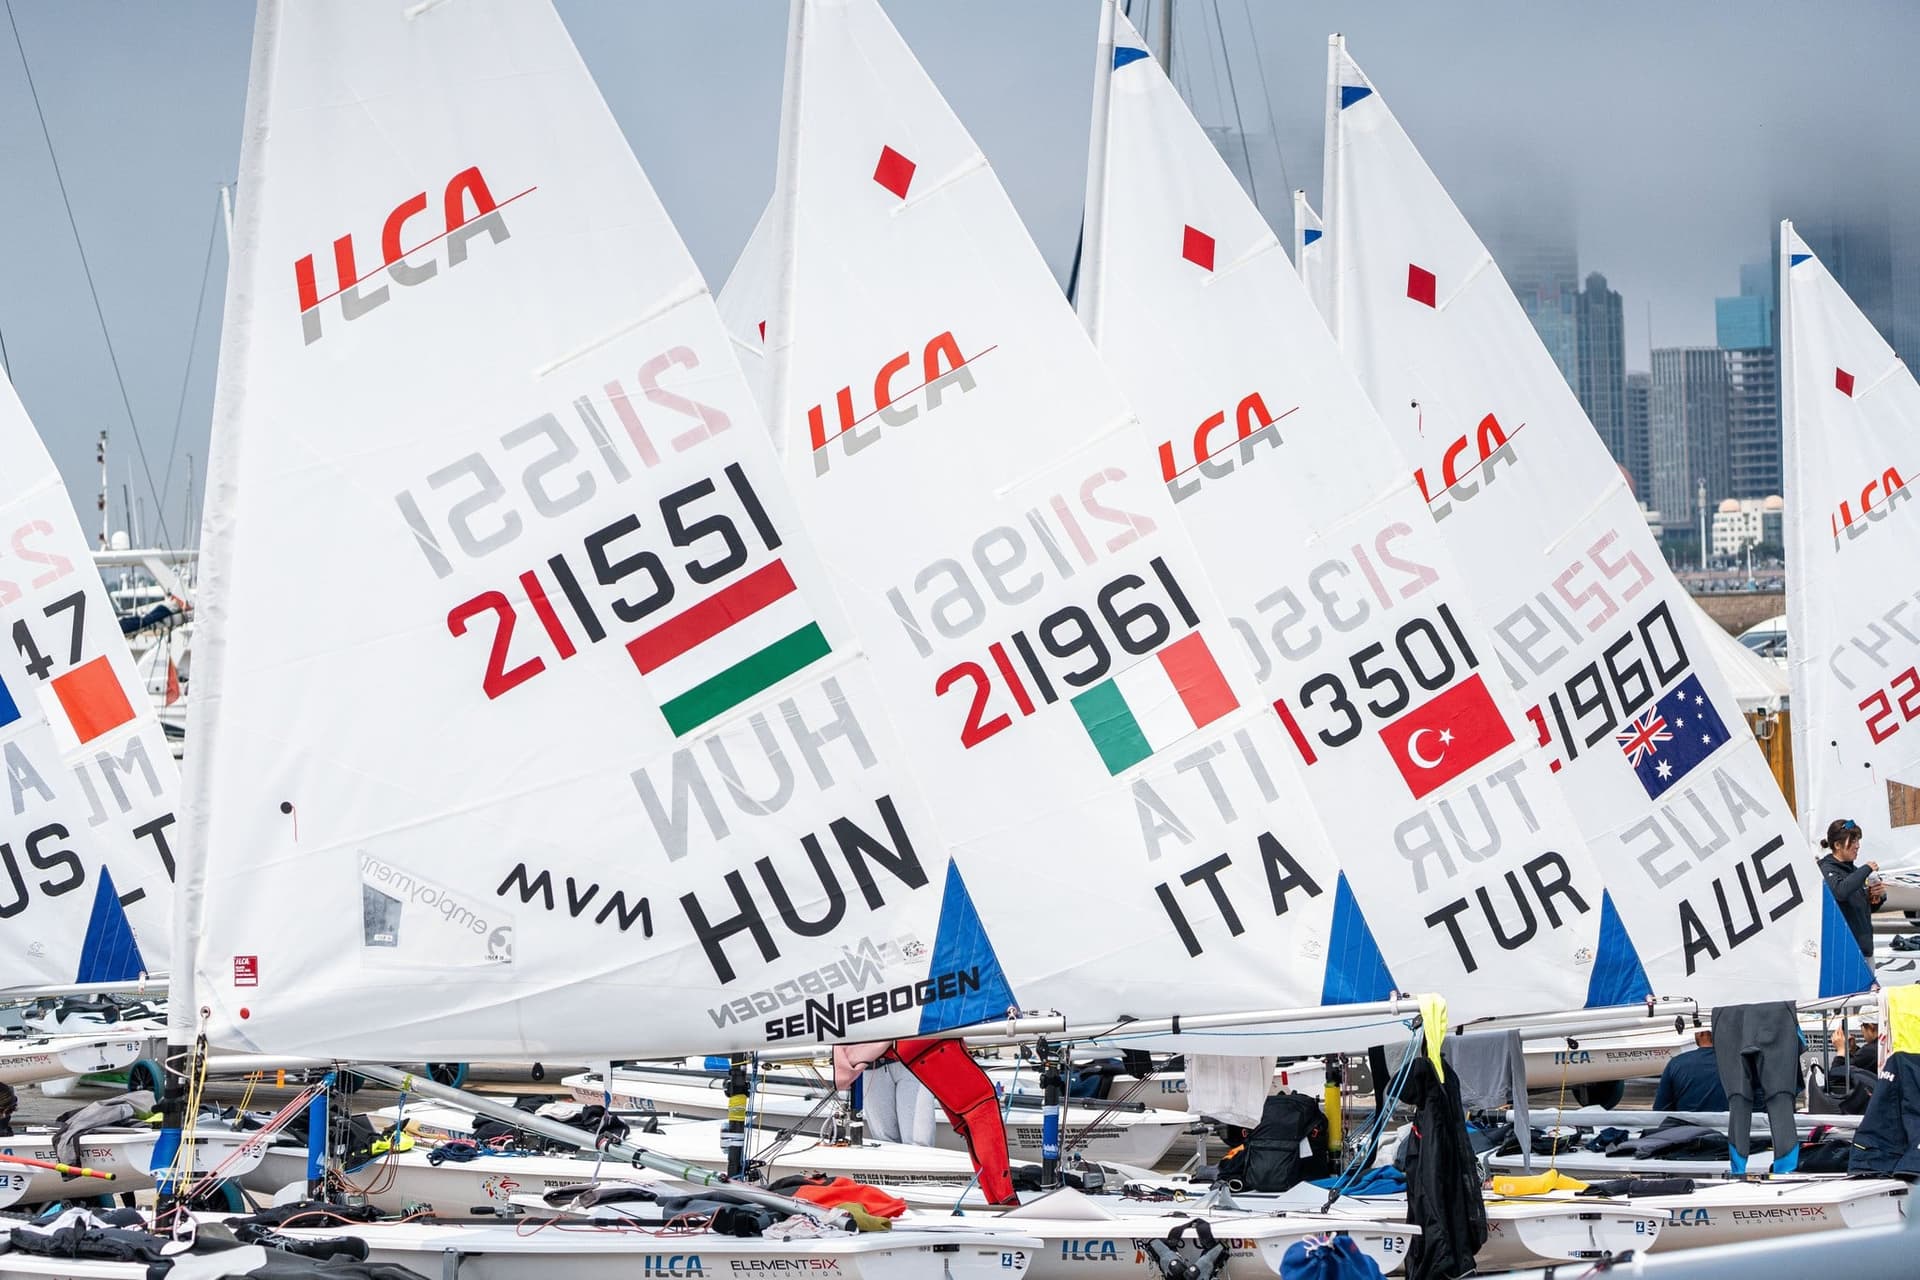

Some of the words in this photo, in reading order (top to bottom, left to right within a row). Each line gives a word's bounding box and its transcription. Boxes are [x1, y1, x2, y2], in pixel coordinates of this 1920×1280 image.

[295, 166, 511, 346] ILCA
[808, 331, 977, 478] ILCA
[1832, 467, 1912, 553] ILCA
[447, 462, 783, 700] 211551
[936, 556, 1201, 750] 211961
[496, 862, 653, 939] MVM
[679, 794, 929, 985] HUN
[1154, 831, 1323, 958] ITA
[1424, 851, 1591, 974] TUR
[1678, 834, 1804, 977] AUS
[765, 965, 981, 1042] SENNEBOGEN
[644, 1255, 706, 1278] ILCA
[730, 1259, 839, 1272] ELEMENTSIX
[1062, 1240, 1118, 1261] ILCA
[1733, 1206, 1825, 1220] ELEMENTSIX
